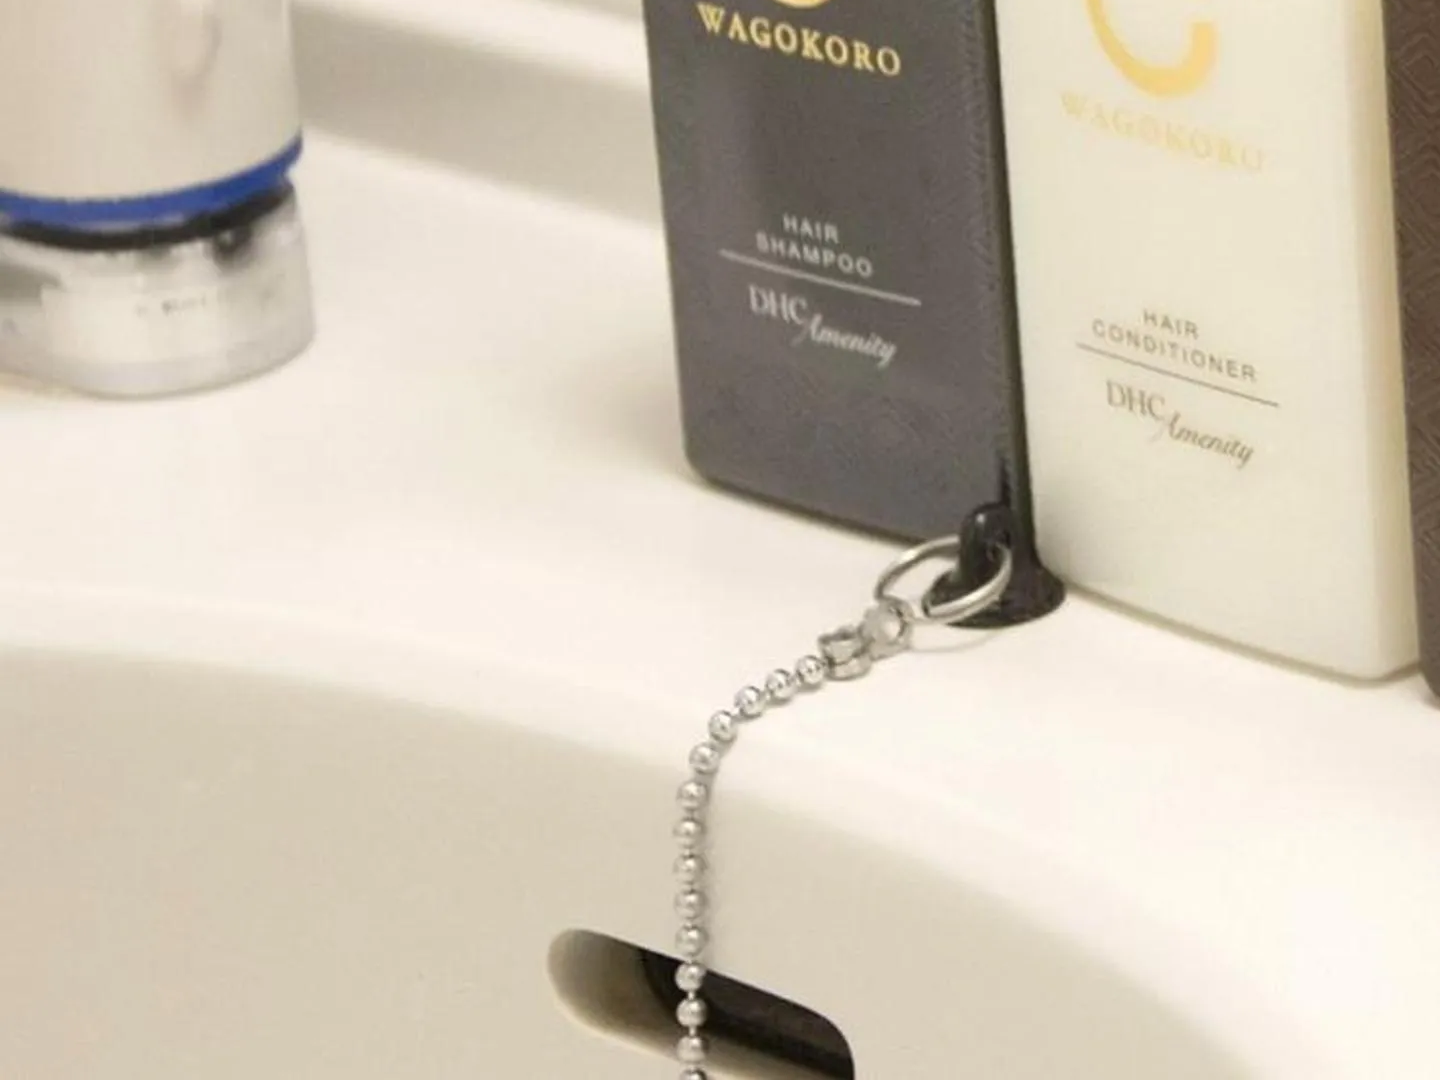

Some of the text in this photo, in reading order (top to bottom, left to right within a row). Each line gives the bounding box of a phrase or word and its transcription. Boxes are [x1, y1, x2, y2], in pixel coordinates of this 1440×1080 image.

[697, 1, 901, 77] WAGOKORO
[1060, 90, 1265, 172] WAGOKORO
[755, 229, 873, 279] SHAMPOO
[782, 212, 839, 244] HAIR
[748, 284, 898, 370] DHC Amenity
[1091, 318, 1258, 383] CONDITIONER
[1142, 308, 1200, 340] HAIR
[1105, 378, 1255, 471] DHC Amenity
